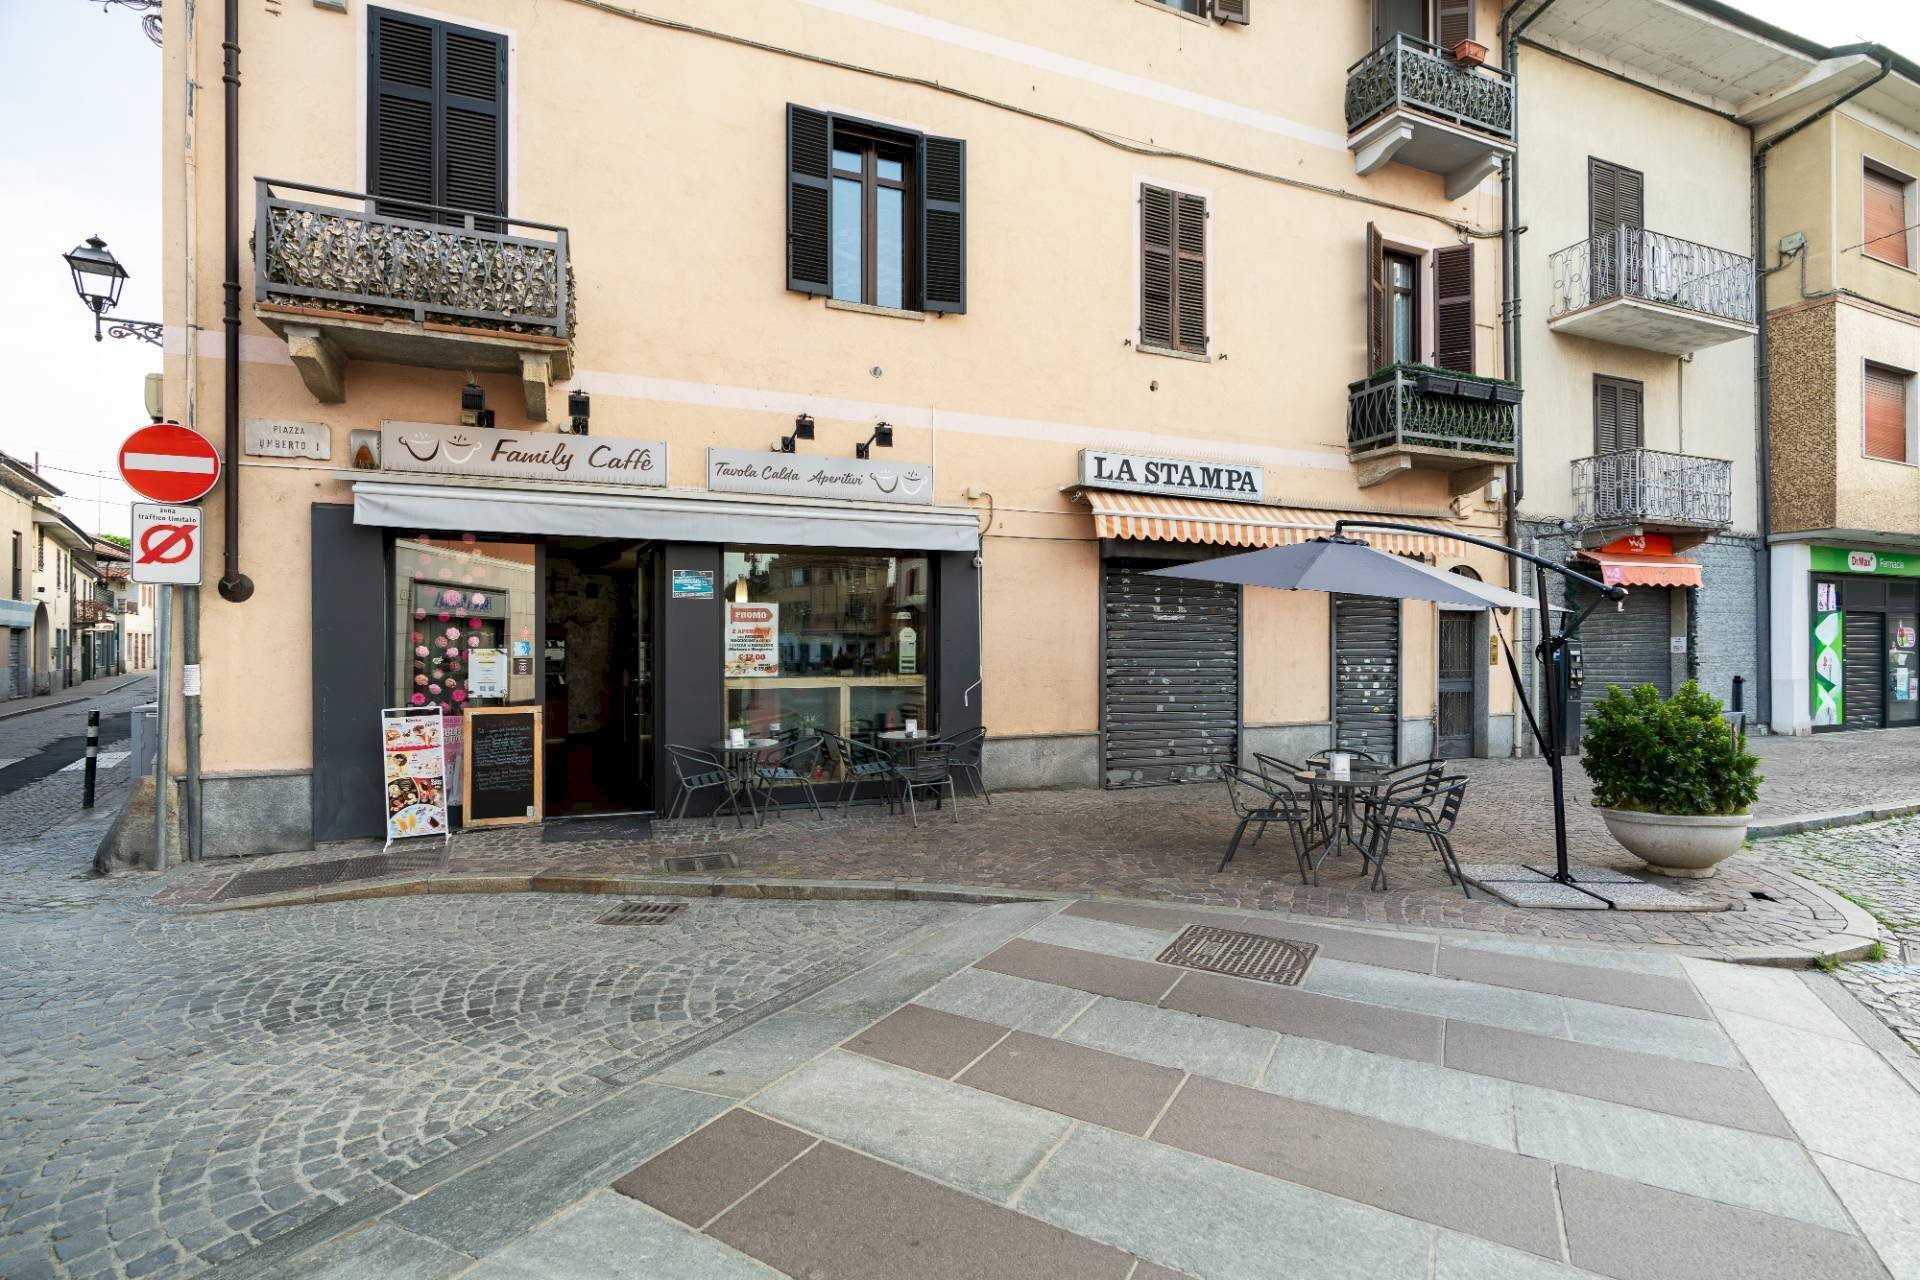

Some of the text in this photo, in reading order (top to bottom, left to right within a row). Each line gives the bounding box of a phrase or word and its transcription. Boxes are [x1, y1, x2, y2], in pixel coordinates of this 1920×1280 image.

[273, 425, 305, 435] PIAZZA
[259, 439, 306, 450] UMBERTO
[490, 438, 654, 472] Family Caffè
[714, 461, 864, 486] Tavola Calda Aperitivi
[1094, 456, 1258, 493] LA STAMPA
[138, 513, 197, 523] traffico limitato
[1879, 558, 1905, 569] Farmacia
[735, 611, 767, 619] PROMO
